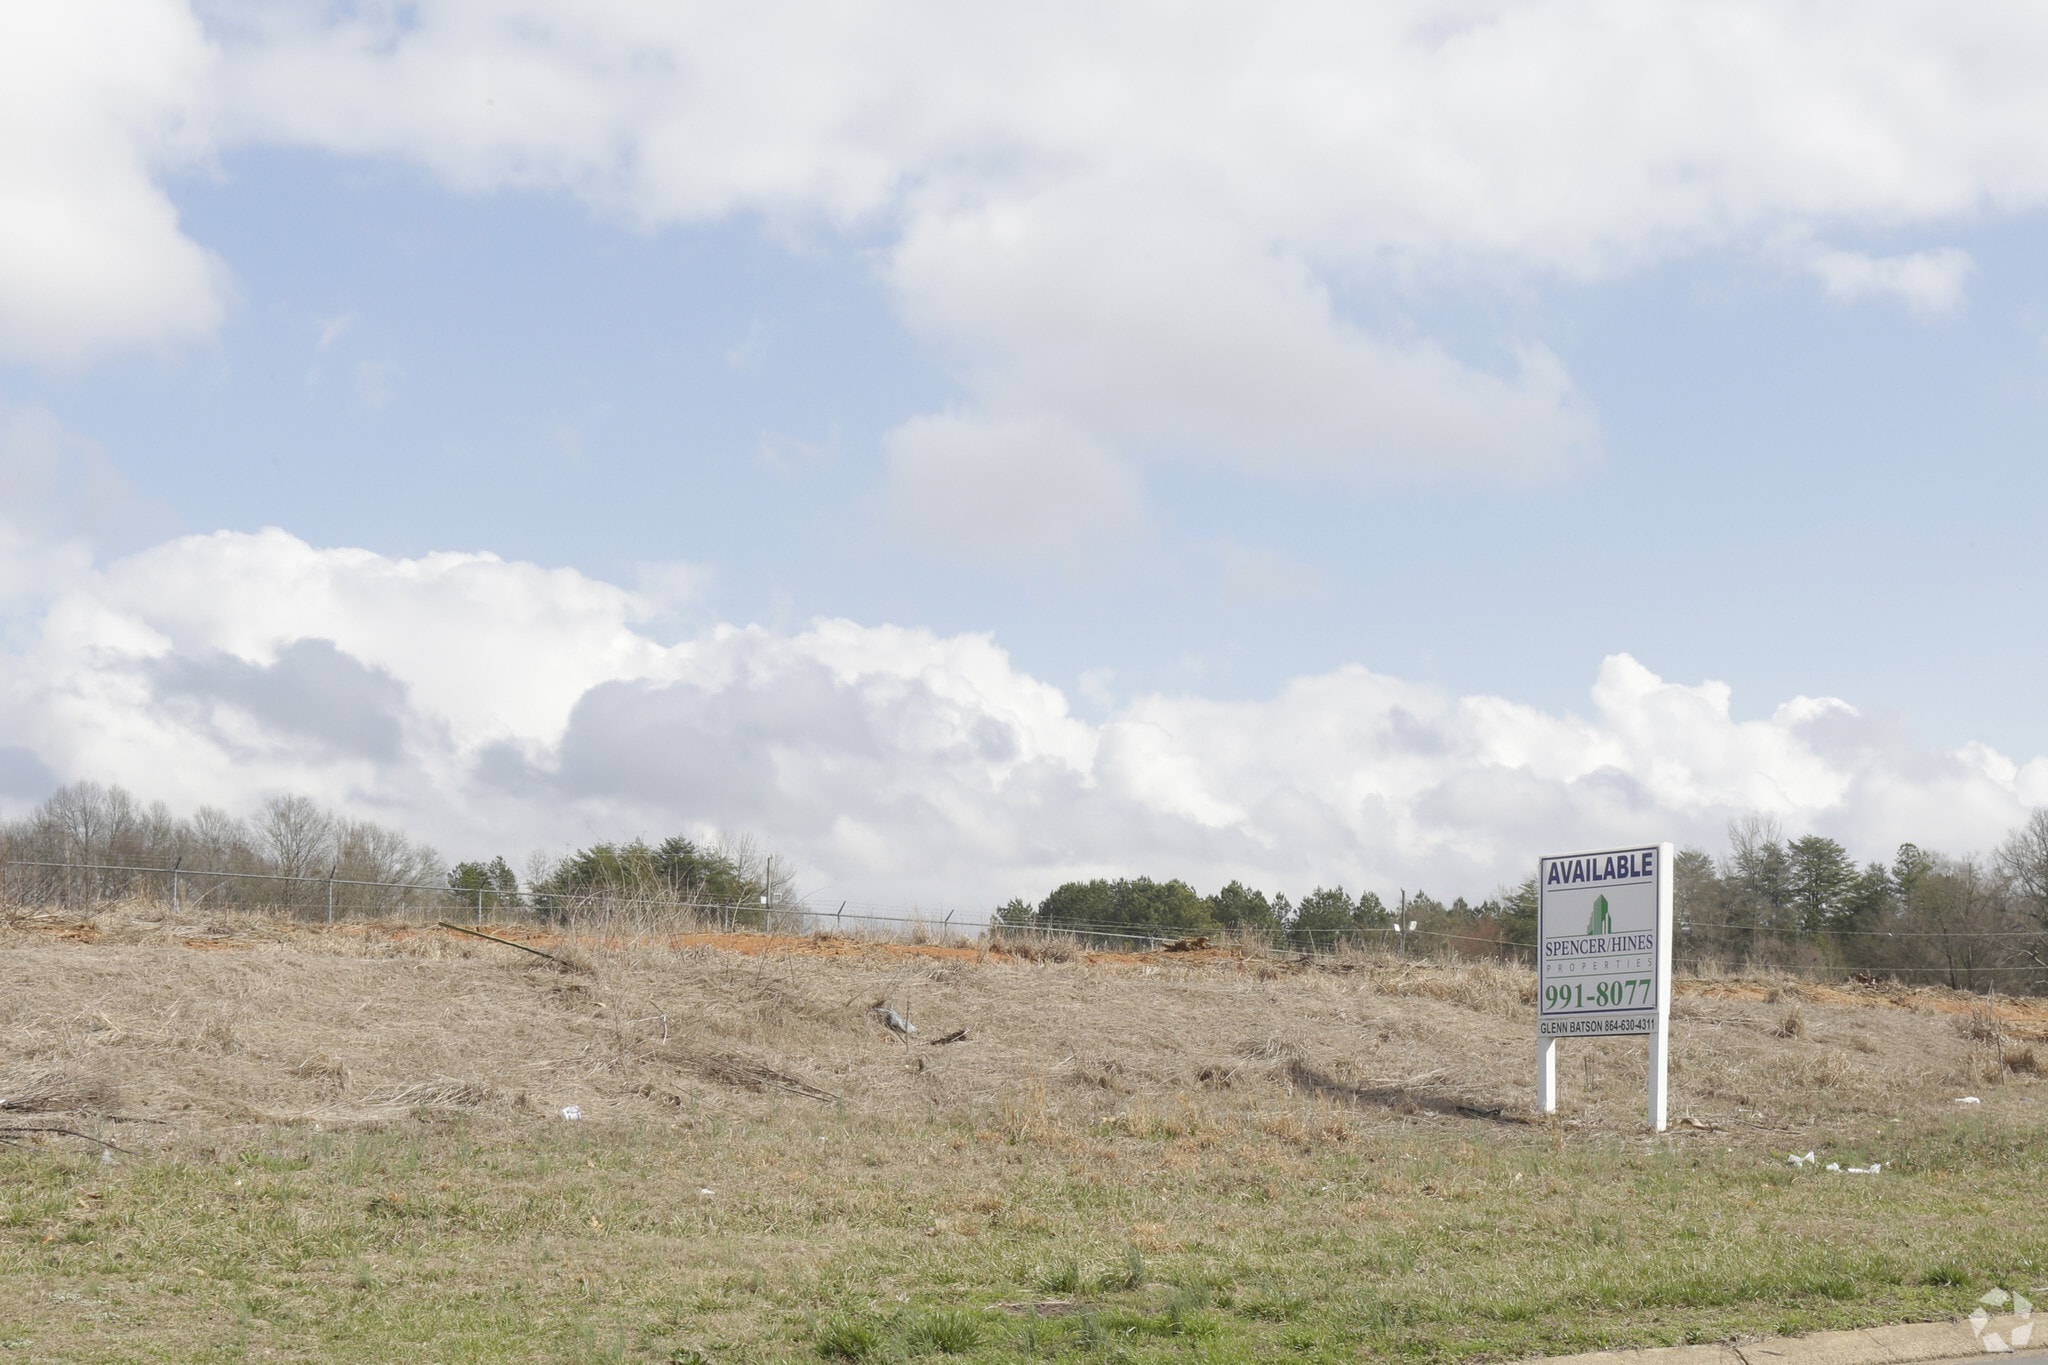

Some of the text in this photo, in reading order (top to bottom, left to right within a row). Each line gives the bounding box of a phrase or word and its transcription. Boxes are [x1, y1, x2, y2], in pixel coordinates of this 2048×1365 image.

[1547, 852, 1653, 885] AVAILABLE
[1545, 934, 1653, 957] SPENCER/HINES
[1546, 957, 1652, 973] PROPERTIES
[1545, 979, 1651, 1010] 991-8077
[1540, 1018, 1655, 1034] GLENN BATSON 864-630-4311
